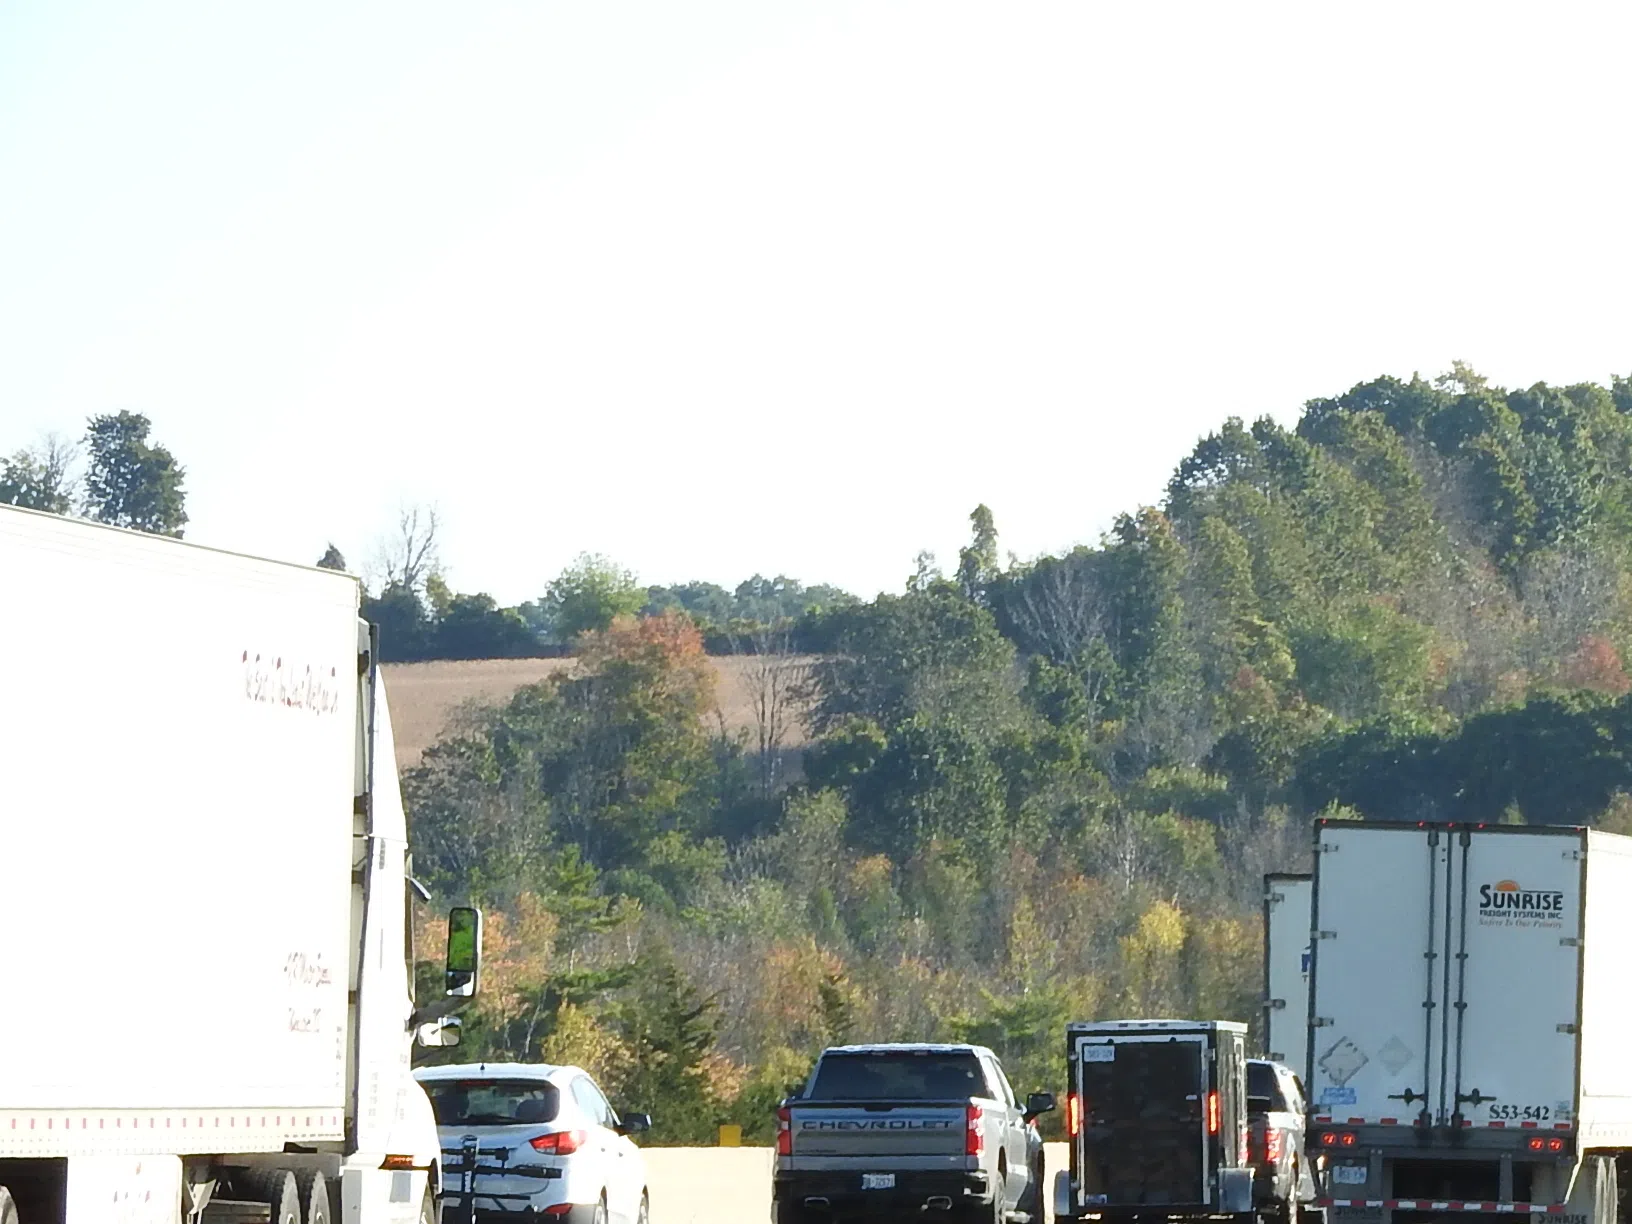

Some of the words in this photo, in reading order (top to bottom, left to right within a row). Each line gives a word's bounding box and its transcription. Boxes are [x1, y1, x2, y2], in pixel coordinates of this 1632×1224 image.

[1479, 884, 1563, 911] SUNRISE
[1479, 909, 1511, 918] FREIGHT
[1513, 911, 1546, 919] SYSTEMS
[1547, 912, 1563, 920] INC.
[1489, 1104, 1549, 1120] S53-542
[802, 1120, 953, 1130] CHEVROLET
